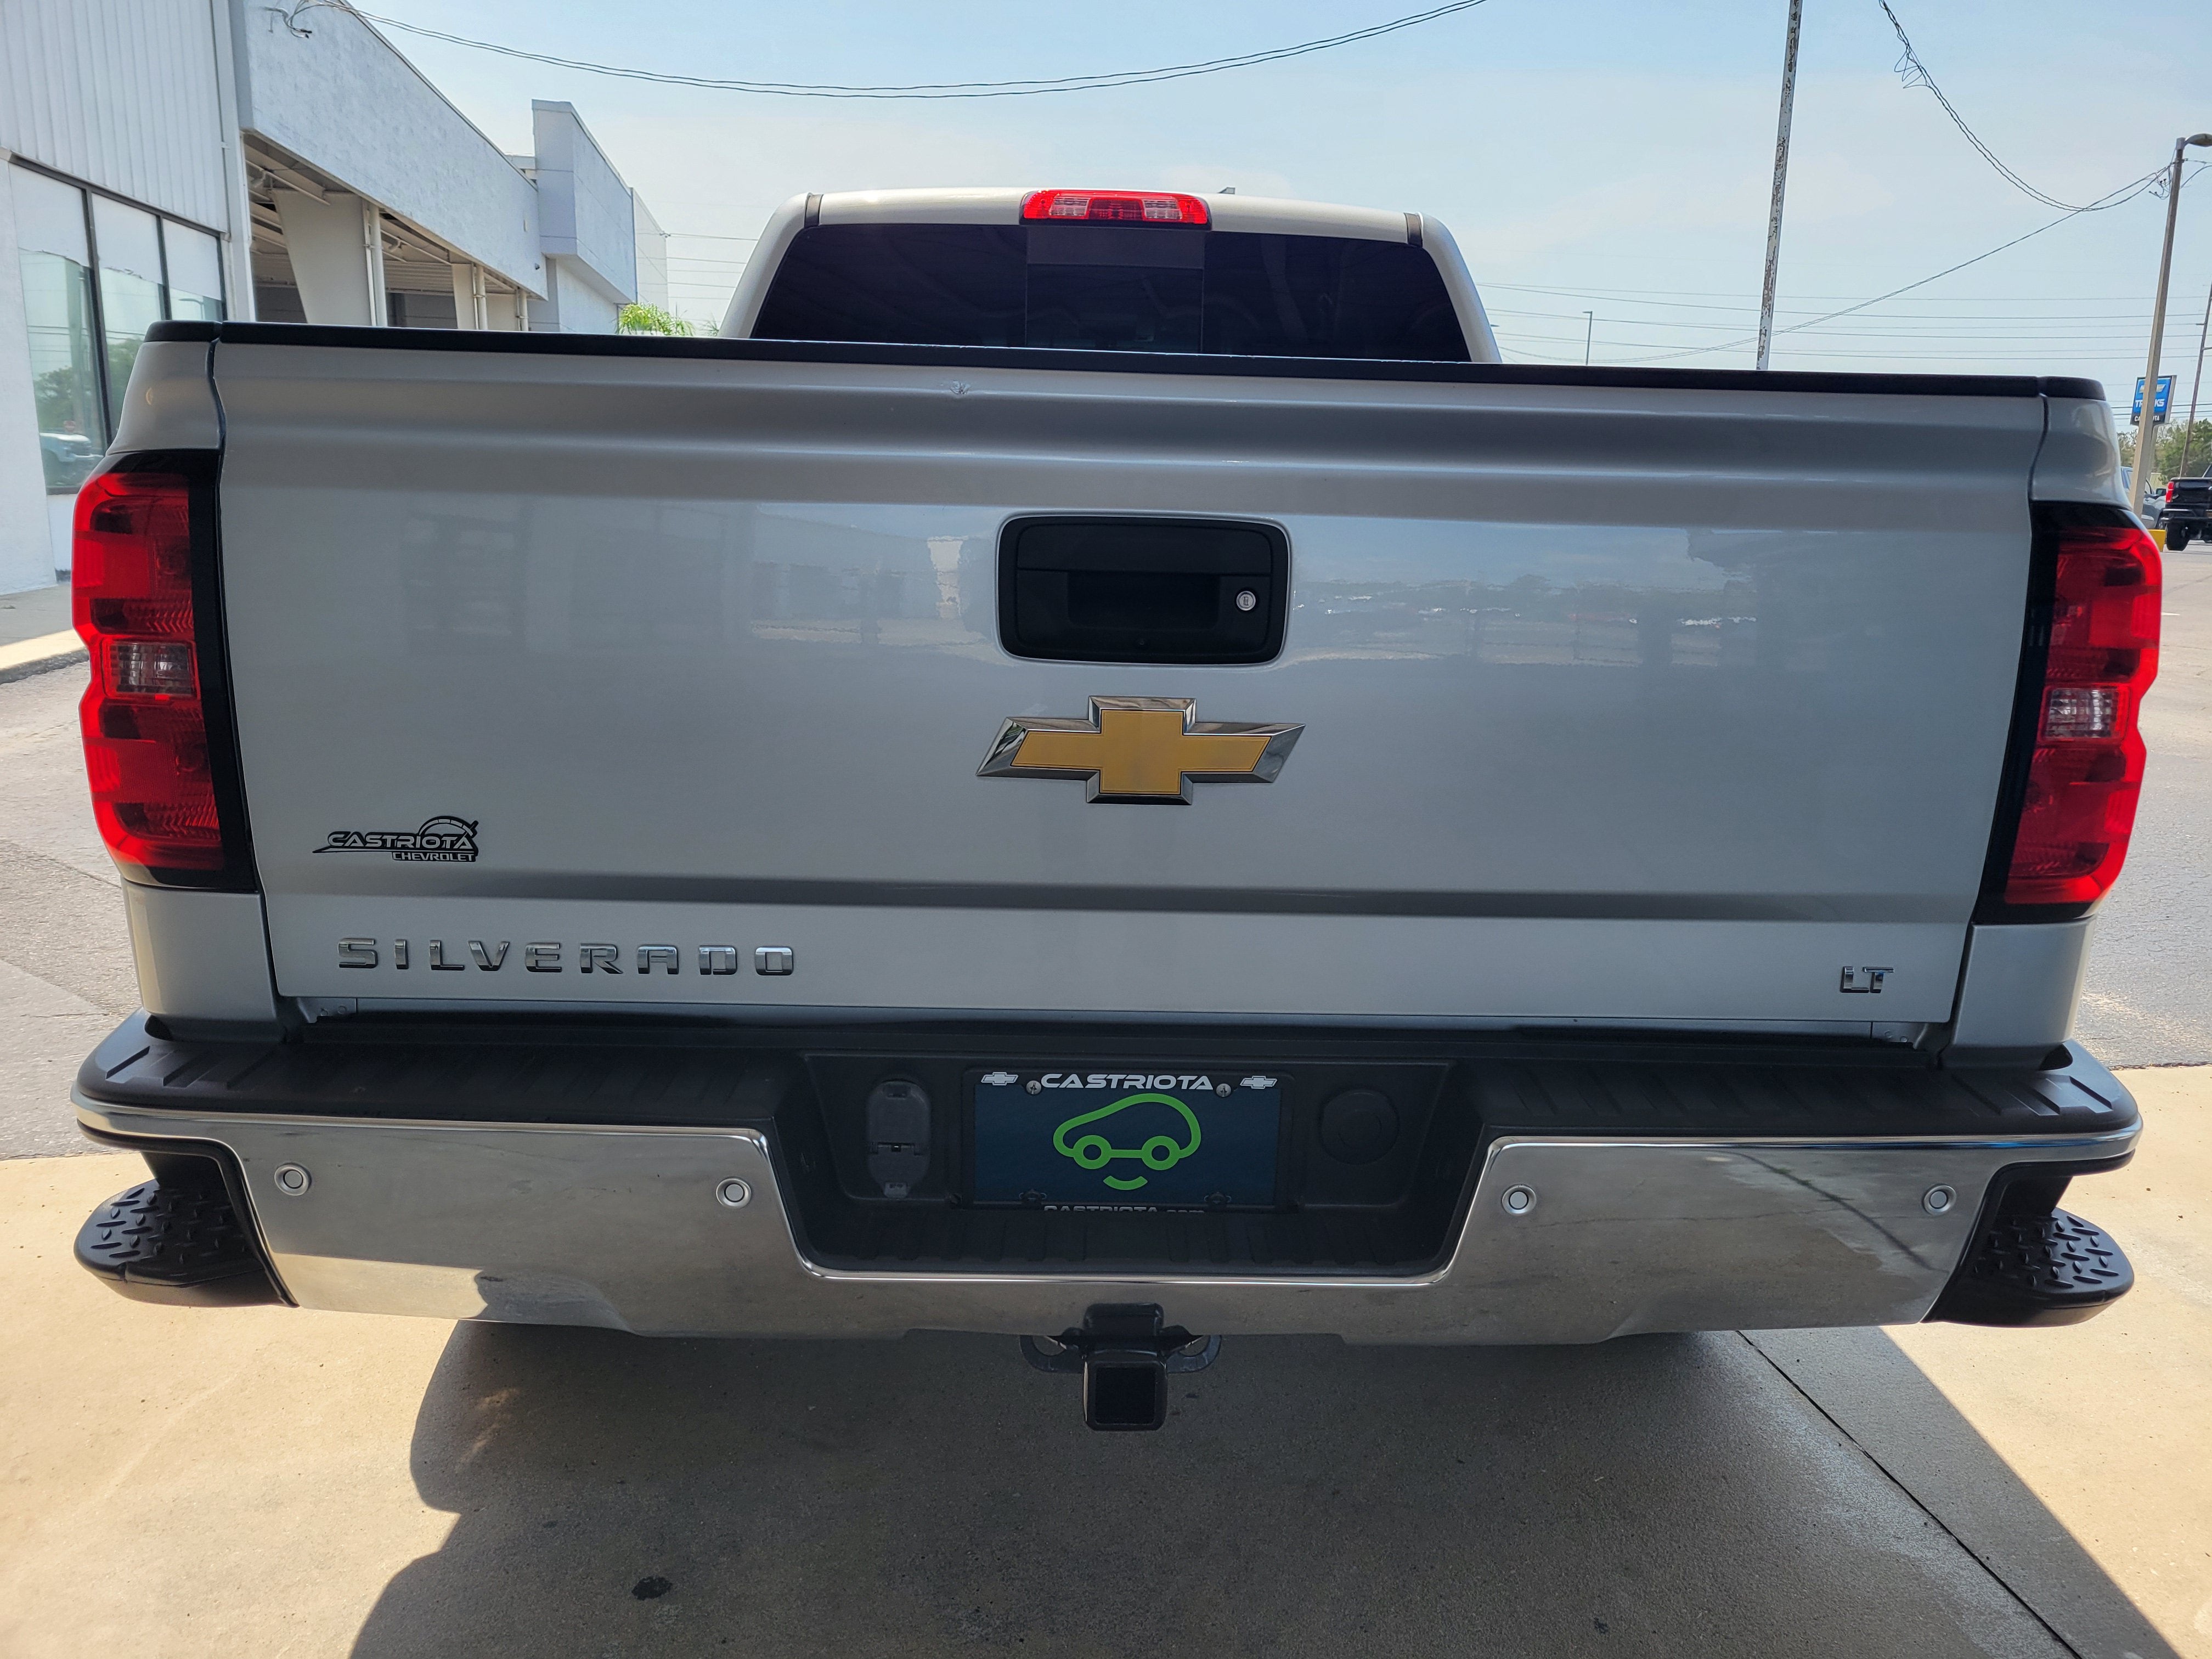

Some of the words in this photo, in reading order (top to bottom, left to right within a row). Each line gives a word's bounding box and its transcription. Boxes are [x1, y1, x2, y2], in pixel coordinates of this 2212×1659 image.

[2135, 399, 2165, 408] TRKS
[328, 834, 474, 849] CASTRIOTA
[392, 852, 475, 861] CHEVROLET
[337, 938, 795, 976] SILVERADO
[1839, 966, 1894, 993] LT
[1041, 1074, 1214, 1090] CASTRIOTA
